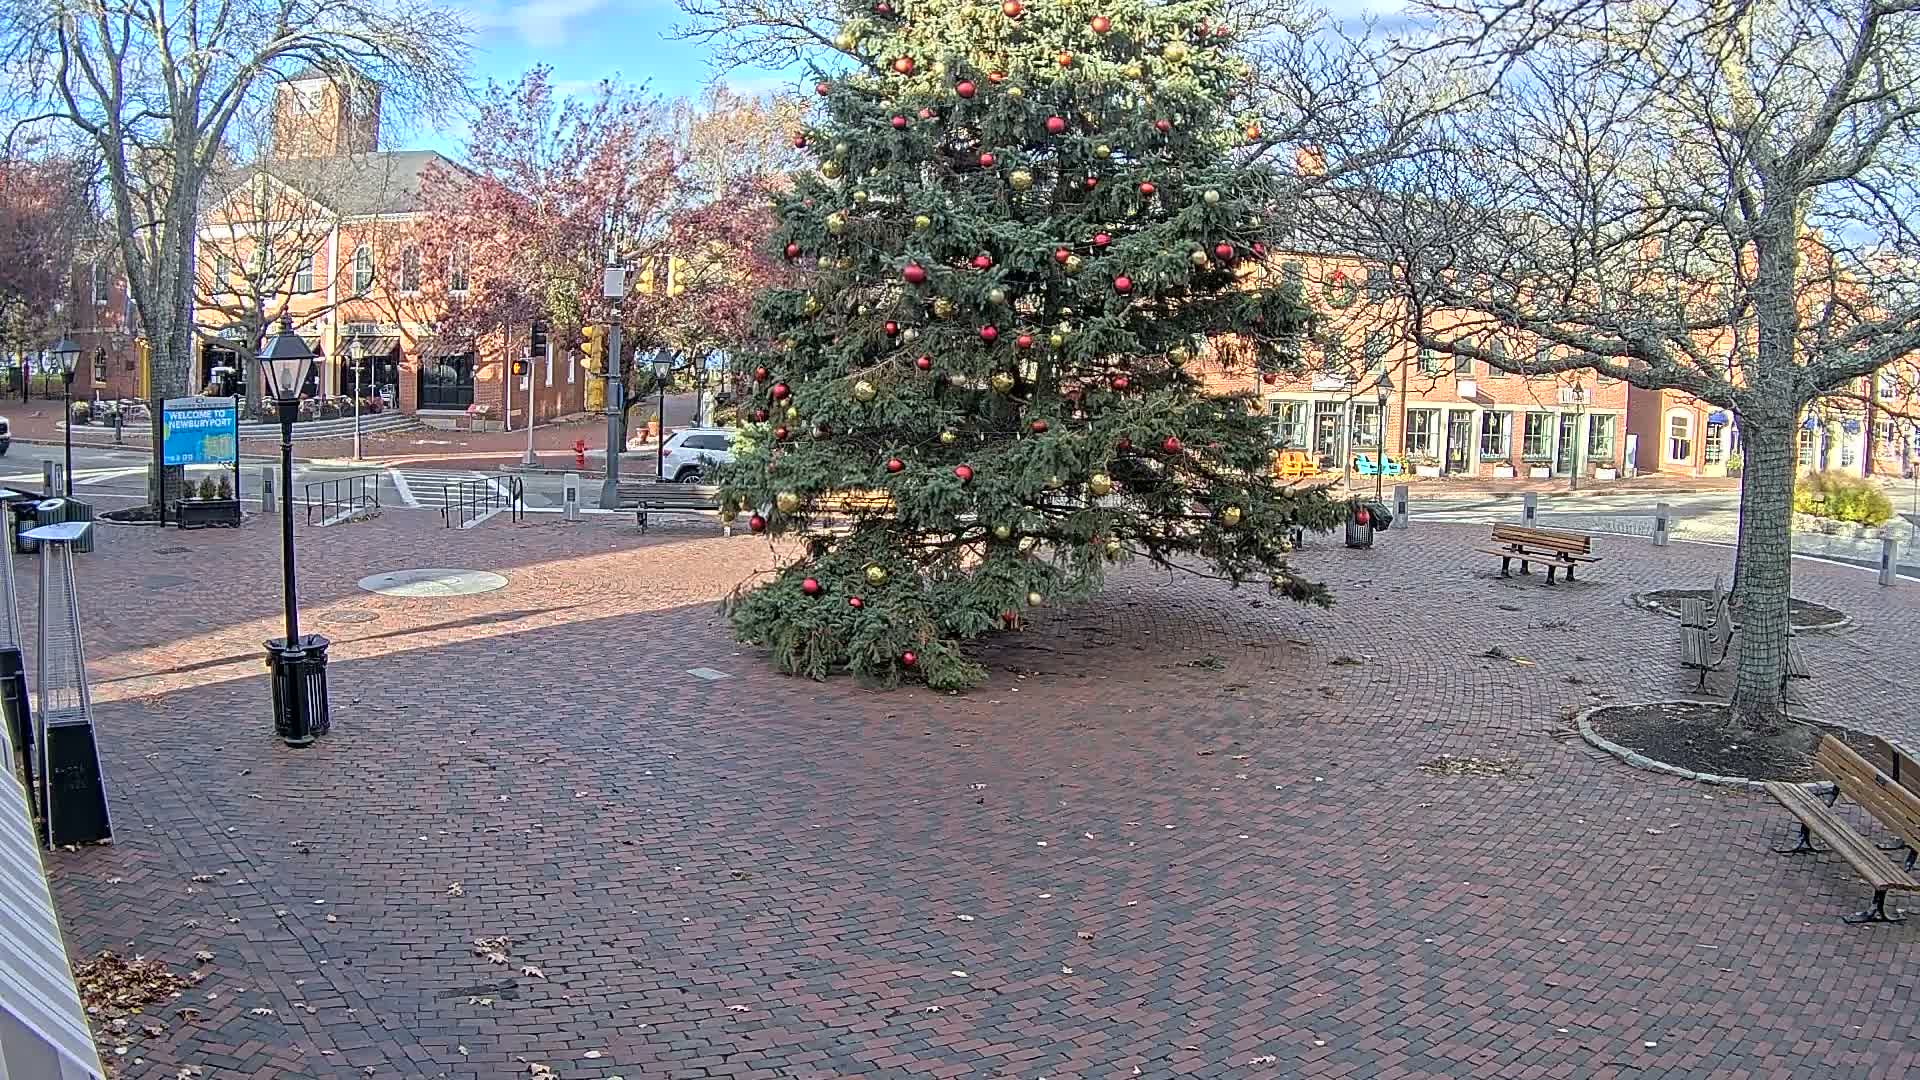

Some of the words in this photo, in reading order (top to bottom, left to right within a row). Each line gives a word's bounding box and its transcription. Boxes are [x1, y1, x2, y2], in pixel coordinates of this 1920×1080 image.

[170, 410, 212, 420] WELCOME
[214, 409, 226, 418] TO
[168, 418, 232, 429] NEWBURYPORT
